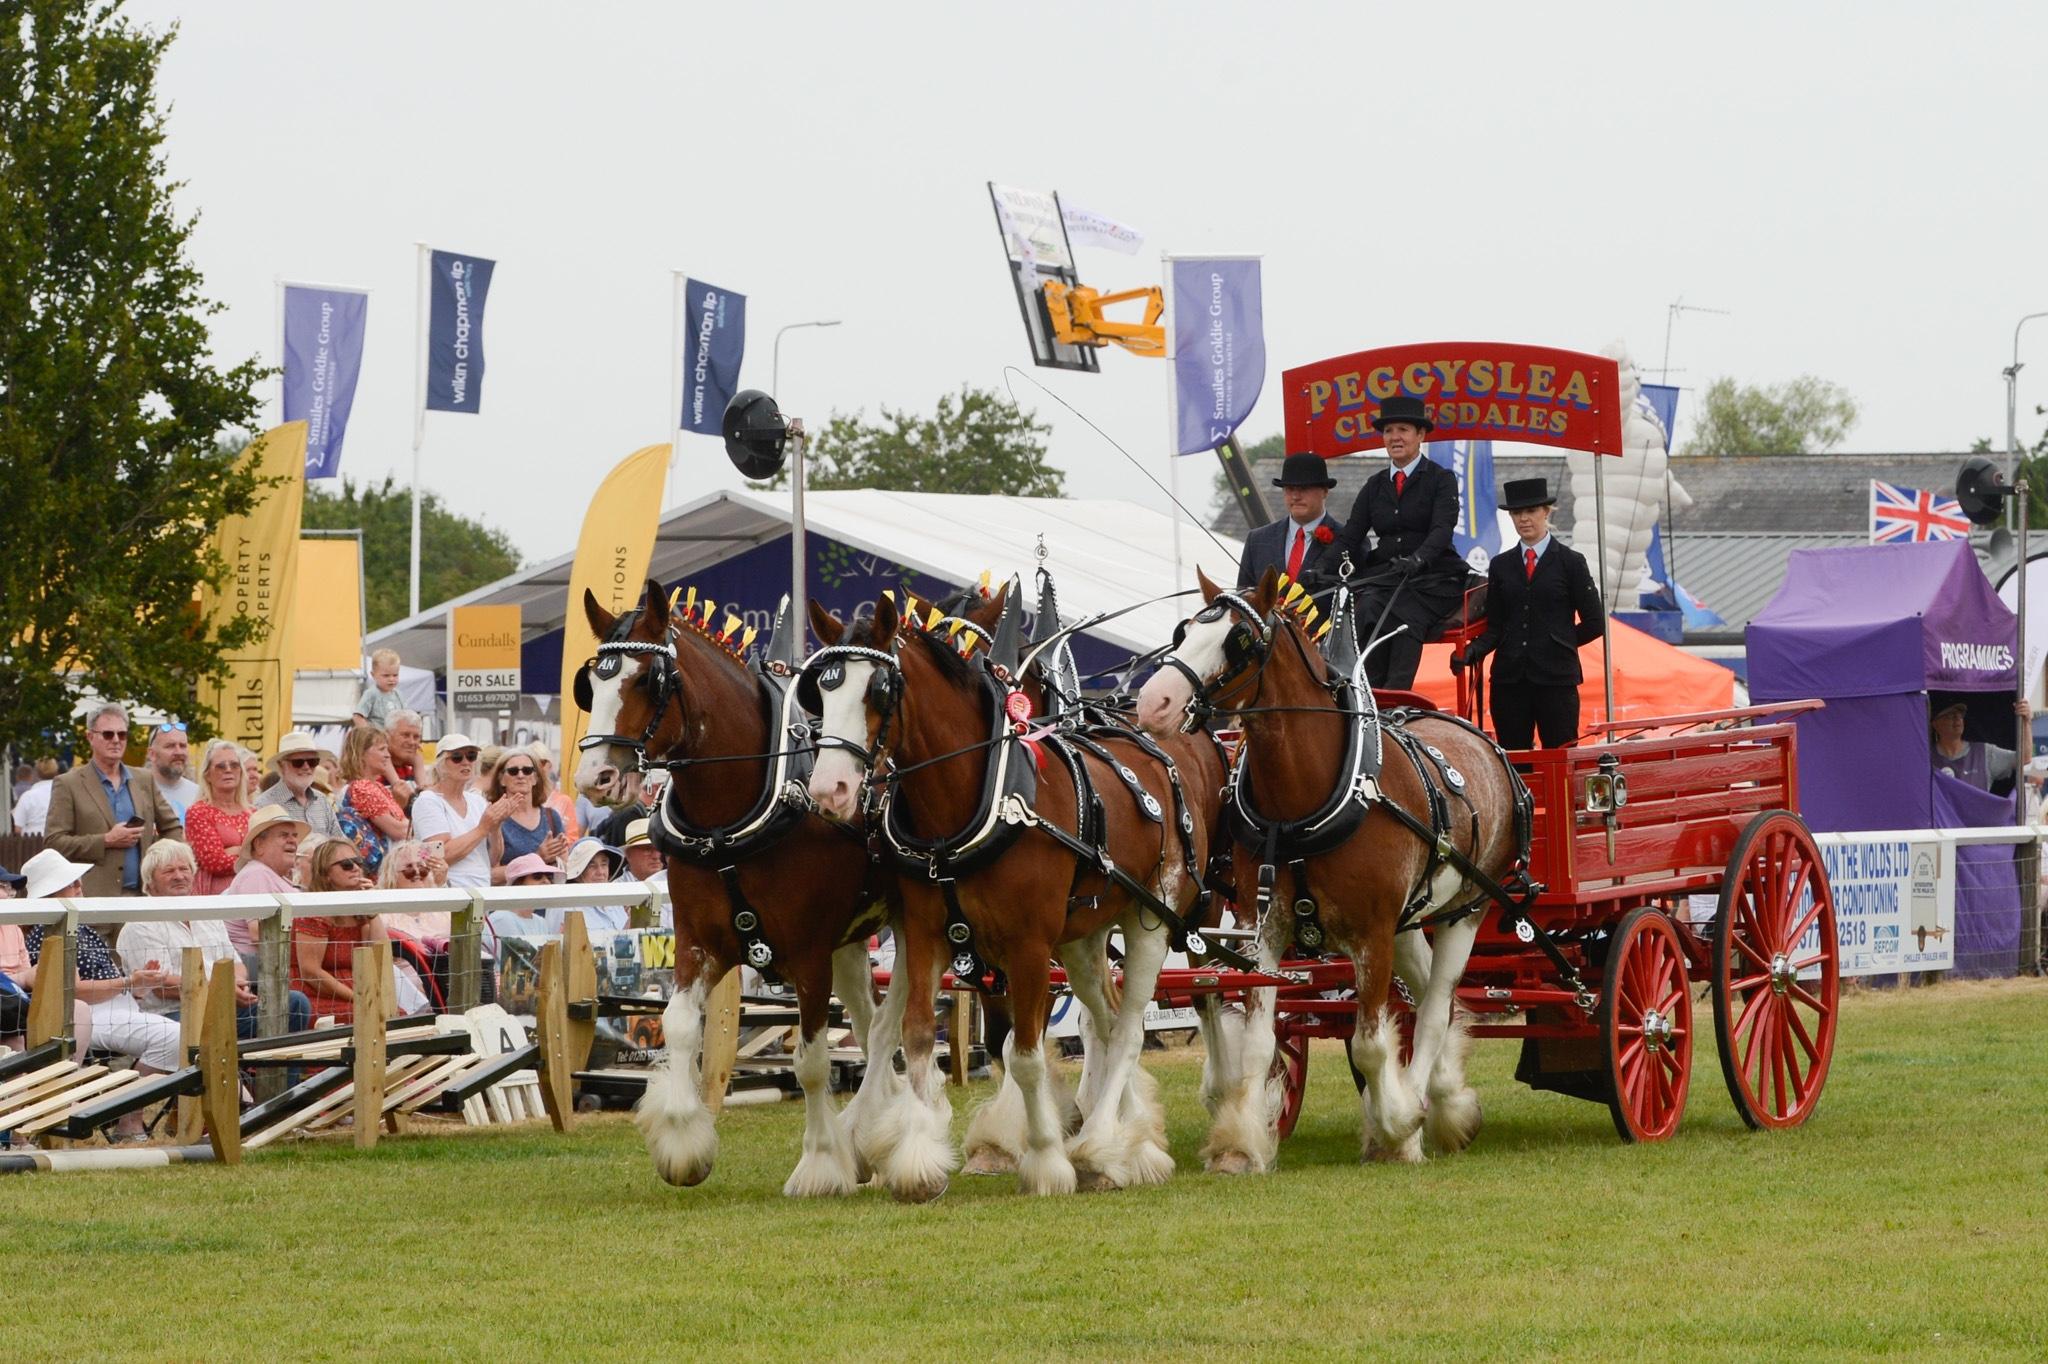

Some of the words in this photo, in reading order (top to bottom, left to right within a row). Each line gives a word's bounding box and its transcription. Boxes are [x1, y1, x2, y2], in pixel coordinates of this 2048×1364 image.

[451, 261, 465, 279] llp
[1209, 273, 1224, 316] Group
[318, 302, 334, 345] Group
[454, 282, 471, 359] chapman
[693, 385, 705, 425] wilkin
[702, 291, 718, 310] llp
[1210, 319, 1223, 365] Goldie
[1225, 332, 1233, 377] ADVANTAGE
[312, 347, 328, 391] Goldie
[452, 362, 468, 404] wilkin
[1308, 360, 1592, 419] PEGGYSLEA
[1212, 368, 1225, 420] Smailes
[308, 395, 324, 446] Smailes
[1334, 402, 1569, 443] CLESDALES
[236, 537, 251, 616] OPERTY
[612, 546, 627, 617] CTIONS
[458, 633, 516, 648] Cundalls
[1940, 642, 2014, 671] PROGRAMMES
[458, 675, 481, 687] FOR
[486, 674, 515, 687] SALE
[598, 658, 616, 670] AN
[822, 668, 840, 681] AN
[1826, 845, 1840, 880] ON
[1841, 844, 1858, 880] THE
[1860, 843, 1891, 879] WOLDS
[1894, 842, 1909, 878] LTD
[1842, 882, 1898, 916] CONDITIONING
[1836, 920, 1866, 947] 2518
[1874, 940, 1899, 954] REFCOM
[1921, 952, 1937, 961] TRAILER
[1939, 951, 1948, 960] HIRE
[500, 1027, 515, 1054] A
